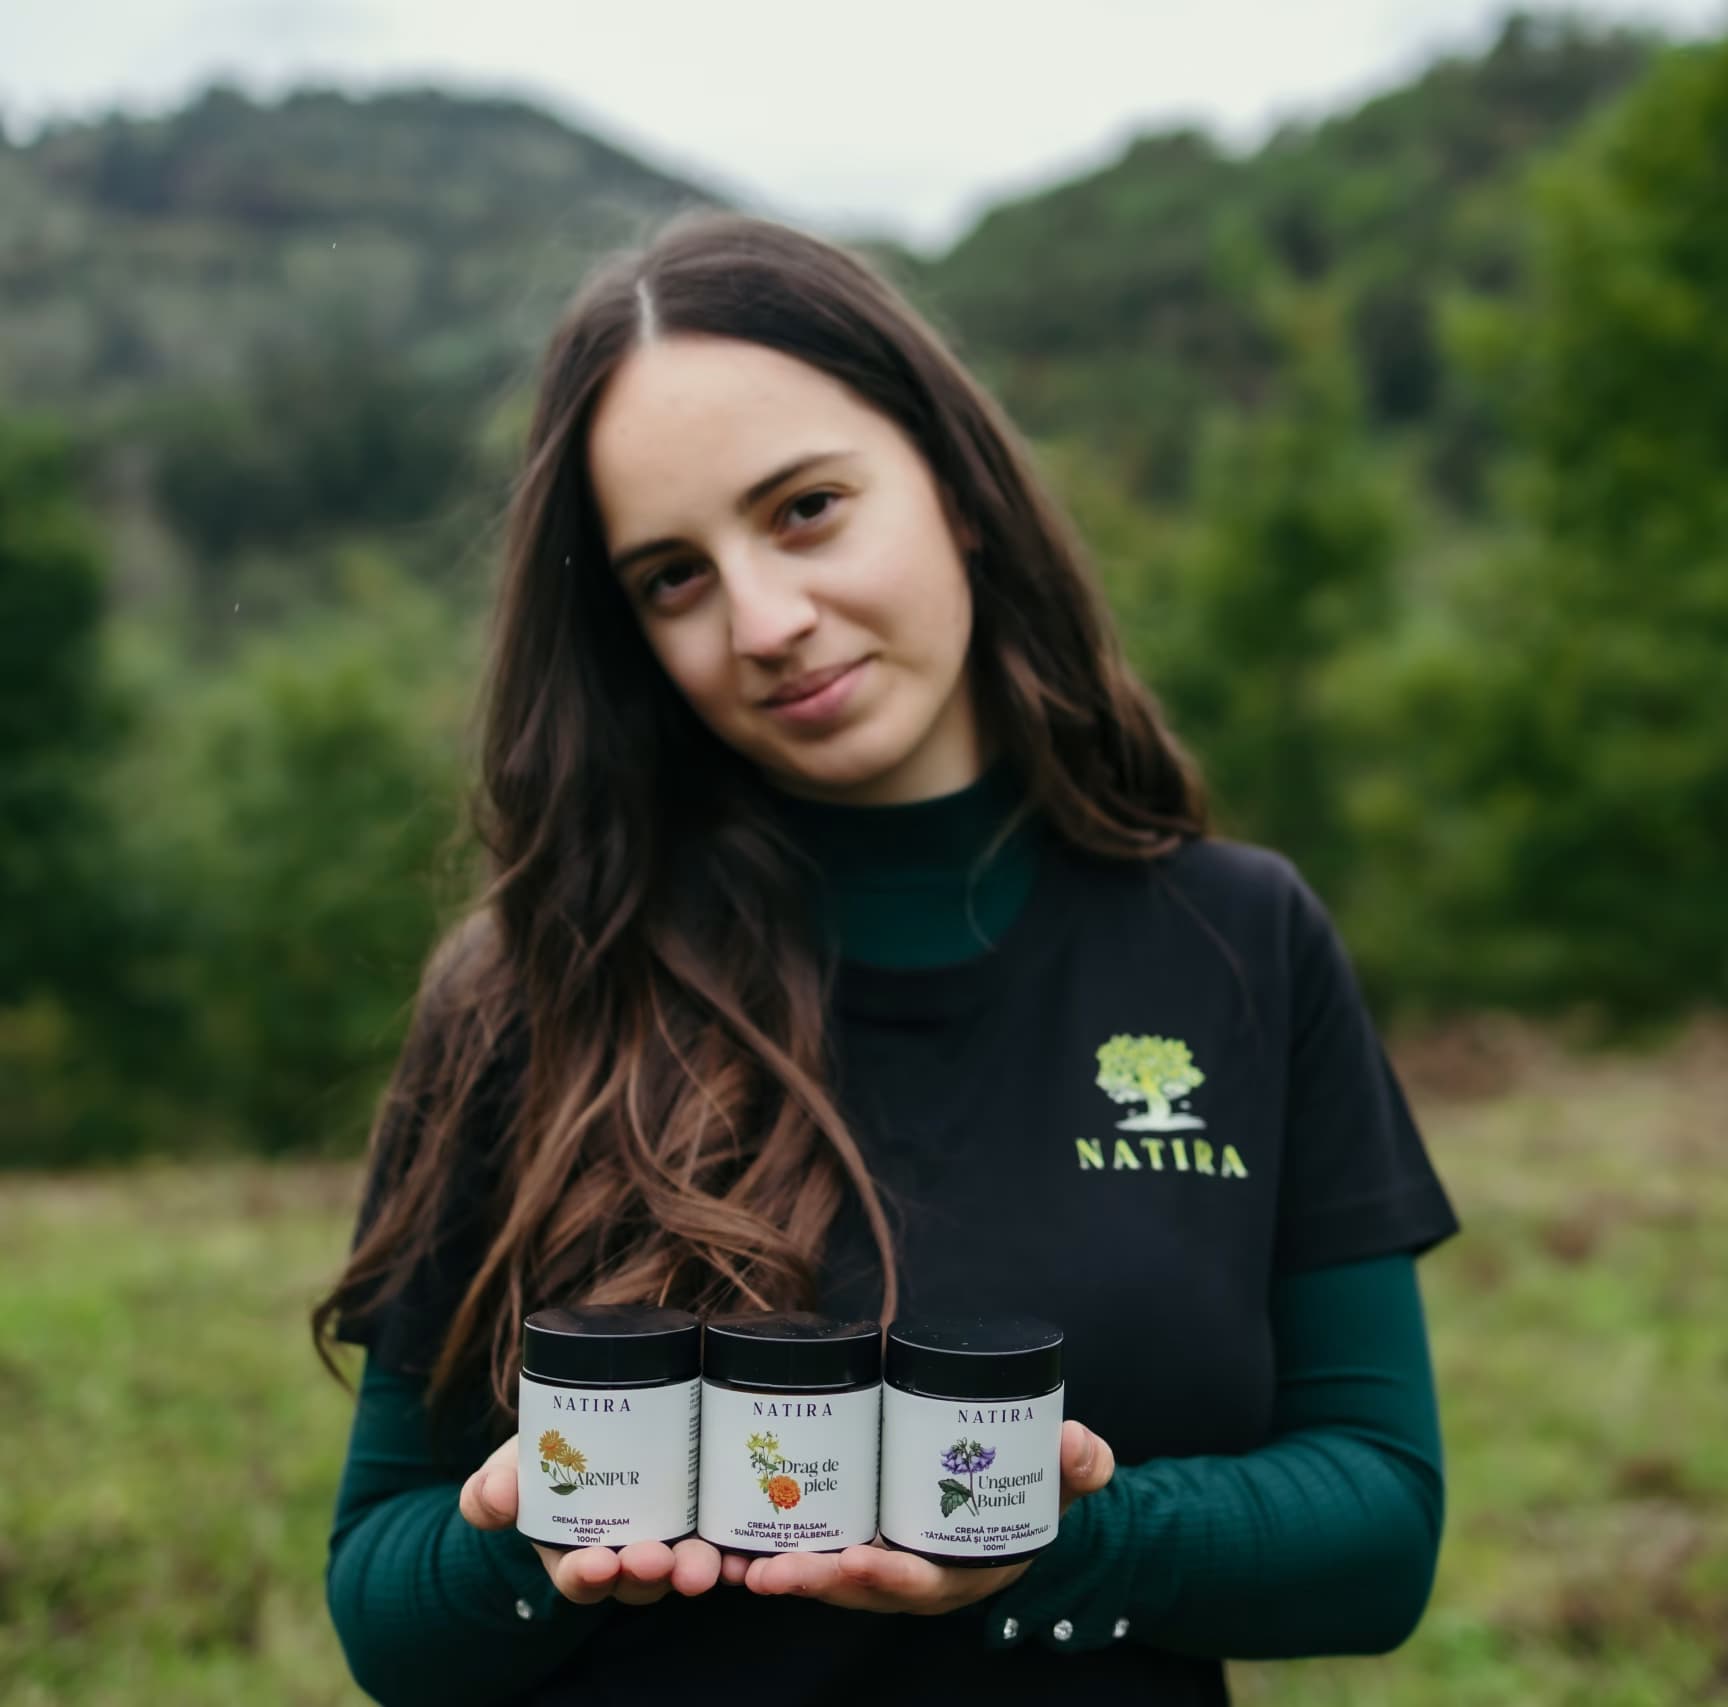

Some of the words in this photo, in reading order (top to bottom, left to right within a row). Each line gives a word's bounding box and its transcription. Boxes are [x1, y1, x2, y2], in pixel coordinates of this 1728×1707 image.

[1075, 1138, 1248, 1178] NATIRA
[553, 1395, 632, 1413] NATIRA
[753, 1401, 833, 1417] NATIRA
[957, 1407, 1034, 1423] NATIRA
[781, 1459, 818, 1477] Drag
[822, 1458, 839, 1473] de
[574, 1471, 640, 1486] ARNIPUR
[978, 1467, 1043, 1493] Unguentul
[803, 1478, 838, 1496] piele
[977, 1490, 1026, 1508] Bunicii
[552, 1515, 579, 1525] CREMĂ
[595, 1518, 630, 1526] BALSAM
[747, 1521, 777, 1530] CREMĂ
[793, 1522, 827, 1531] BALSAM
[954, 1525, 985, 1534] CREMĂ
[1001, 1522, 1031, 1533] BALSAM
[577, 1535, 601, 1543] 100ml
[734, 1528, 781, 1539] SUNĂTOARE
[794, 1529, 840, 1540] GĂLBENELE
[983, 1534, 1010, 1543] UNTUL
[983, 1543, 1006, 1551] 100ml
